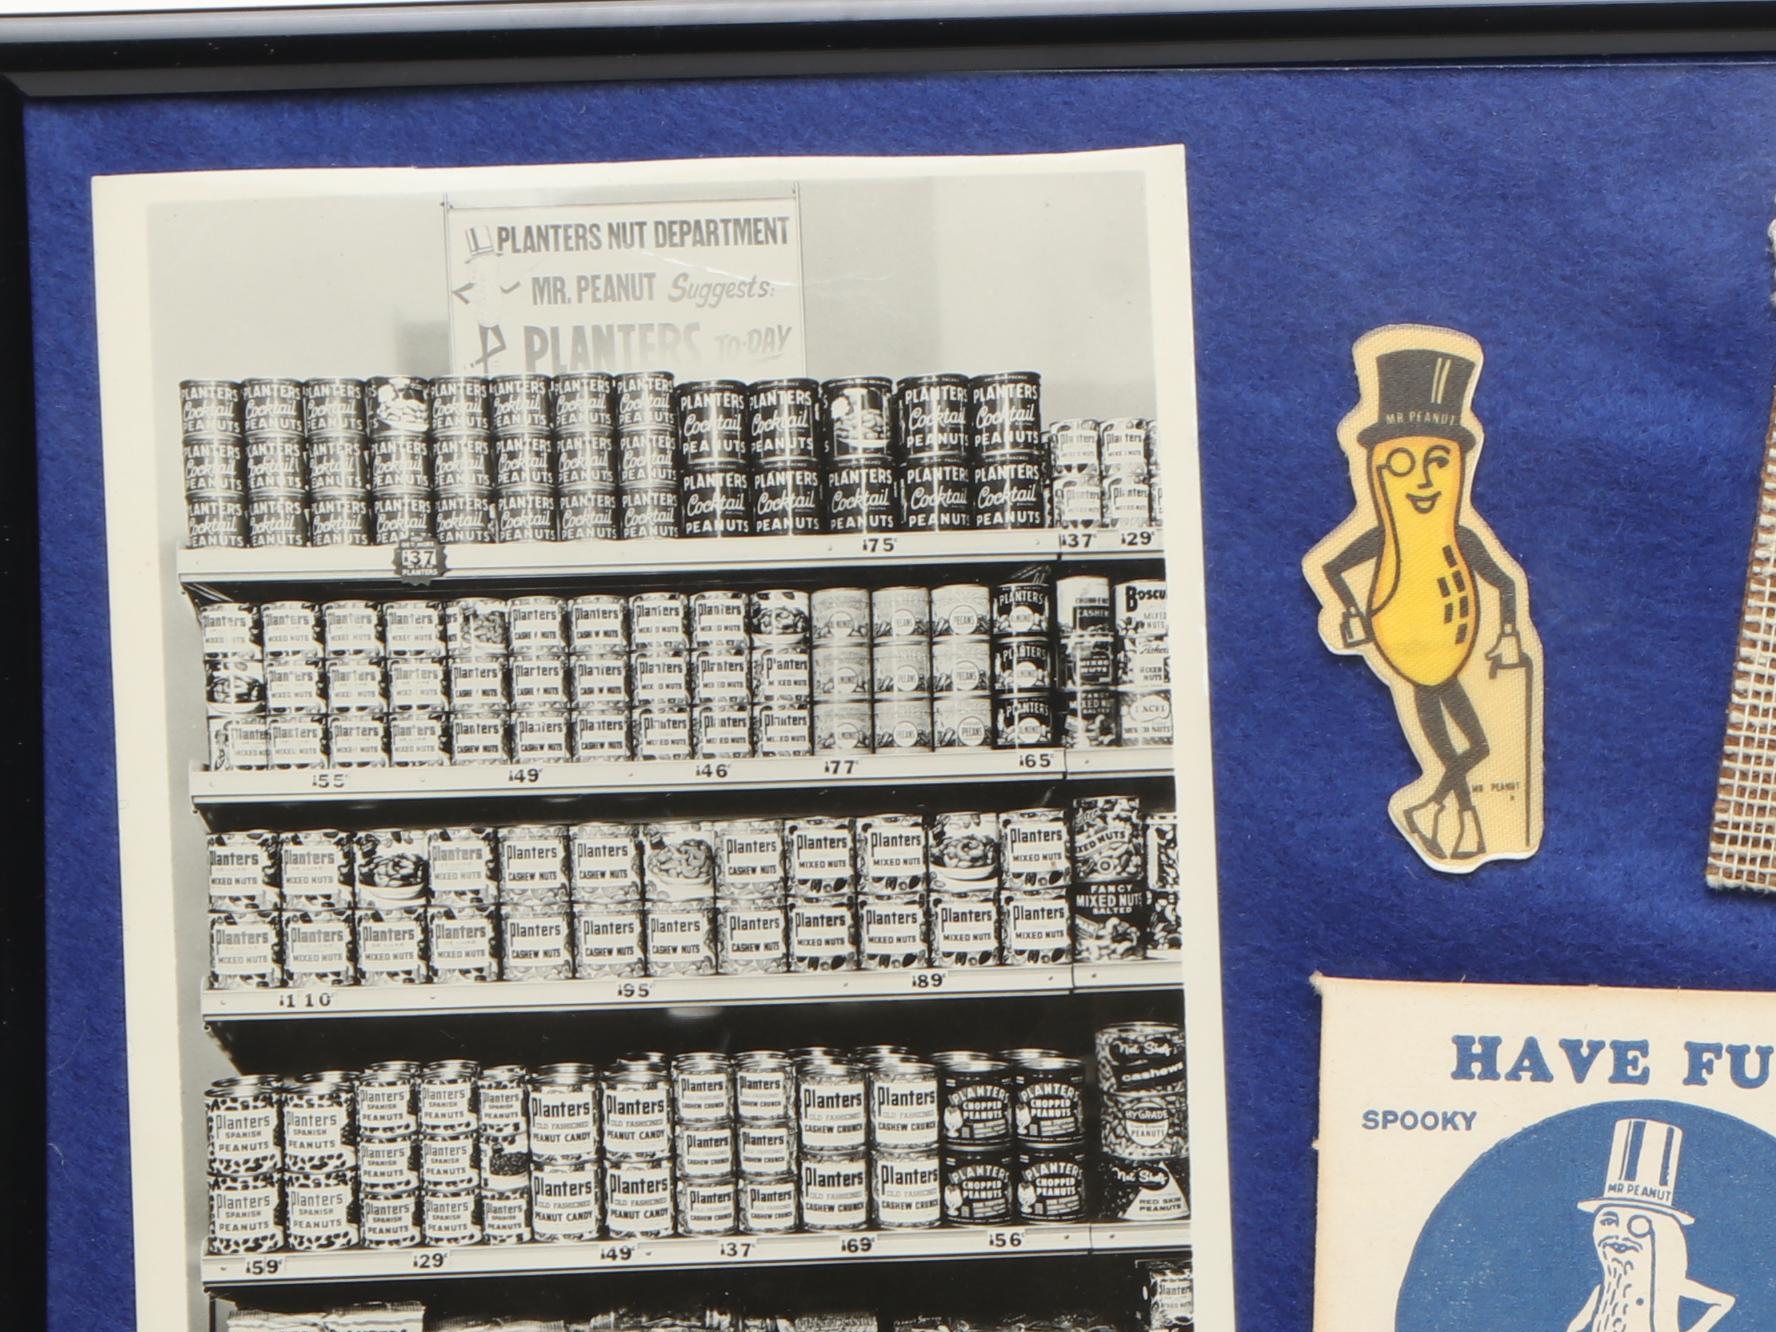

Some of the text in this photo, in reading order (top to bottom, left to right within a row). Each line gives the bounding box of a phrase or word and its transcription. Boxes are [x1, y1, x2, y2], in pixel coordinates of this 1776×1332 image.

[497, 216, 789, 254] PLANTERS NUT DEPARTMENT
[532, 276, 571, 305] MR.
[577, 273, 656, 302] PEANUT
[523, 322, 701, 373] PLANTERS
[755, 470, 818, 490] PLANTERS
[756, 517, 819, 533] PEANUTS
[584, 920, 634, 944] Planters
[866, 910, 917, 934] Planters
[868, 934, 894, 944] MIXED
[1451, 1035, 1650, 1084] HAVE
[532, 1098, 590, 1127] Planters
[1031, 1099, 1071, 1108] CHOPPED
[1031, 1108, 1071, 1117] PEANUTS
[1361, 1109, 1478, 1132] SPOOKY
[1627, 1184, 1672, 1201] PEANUT
